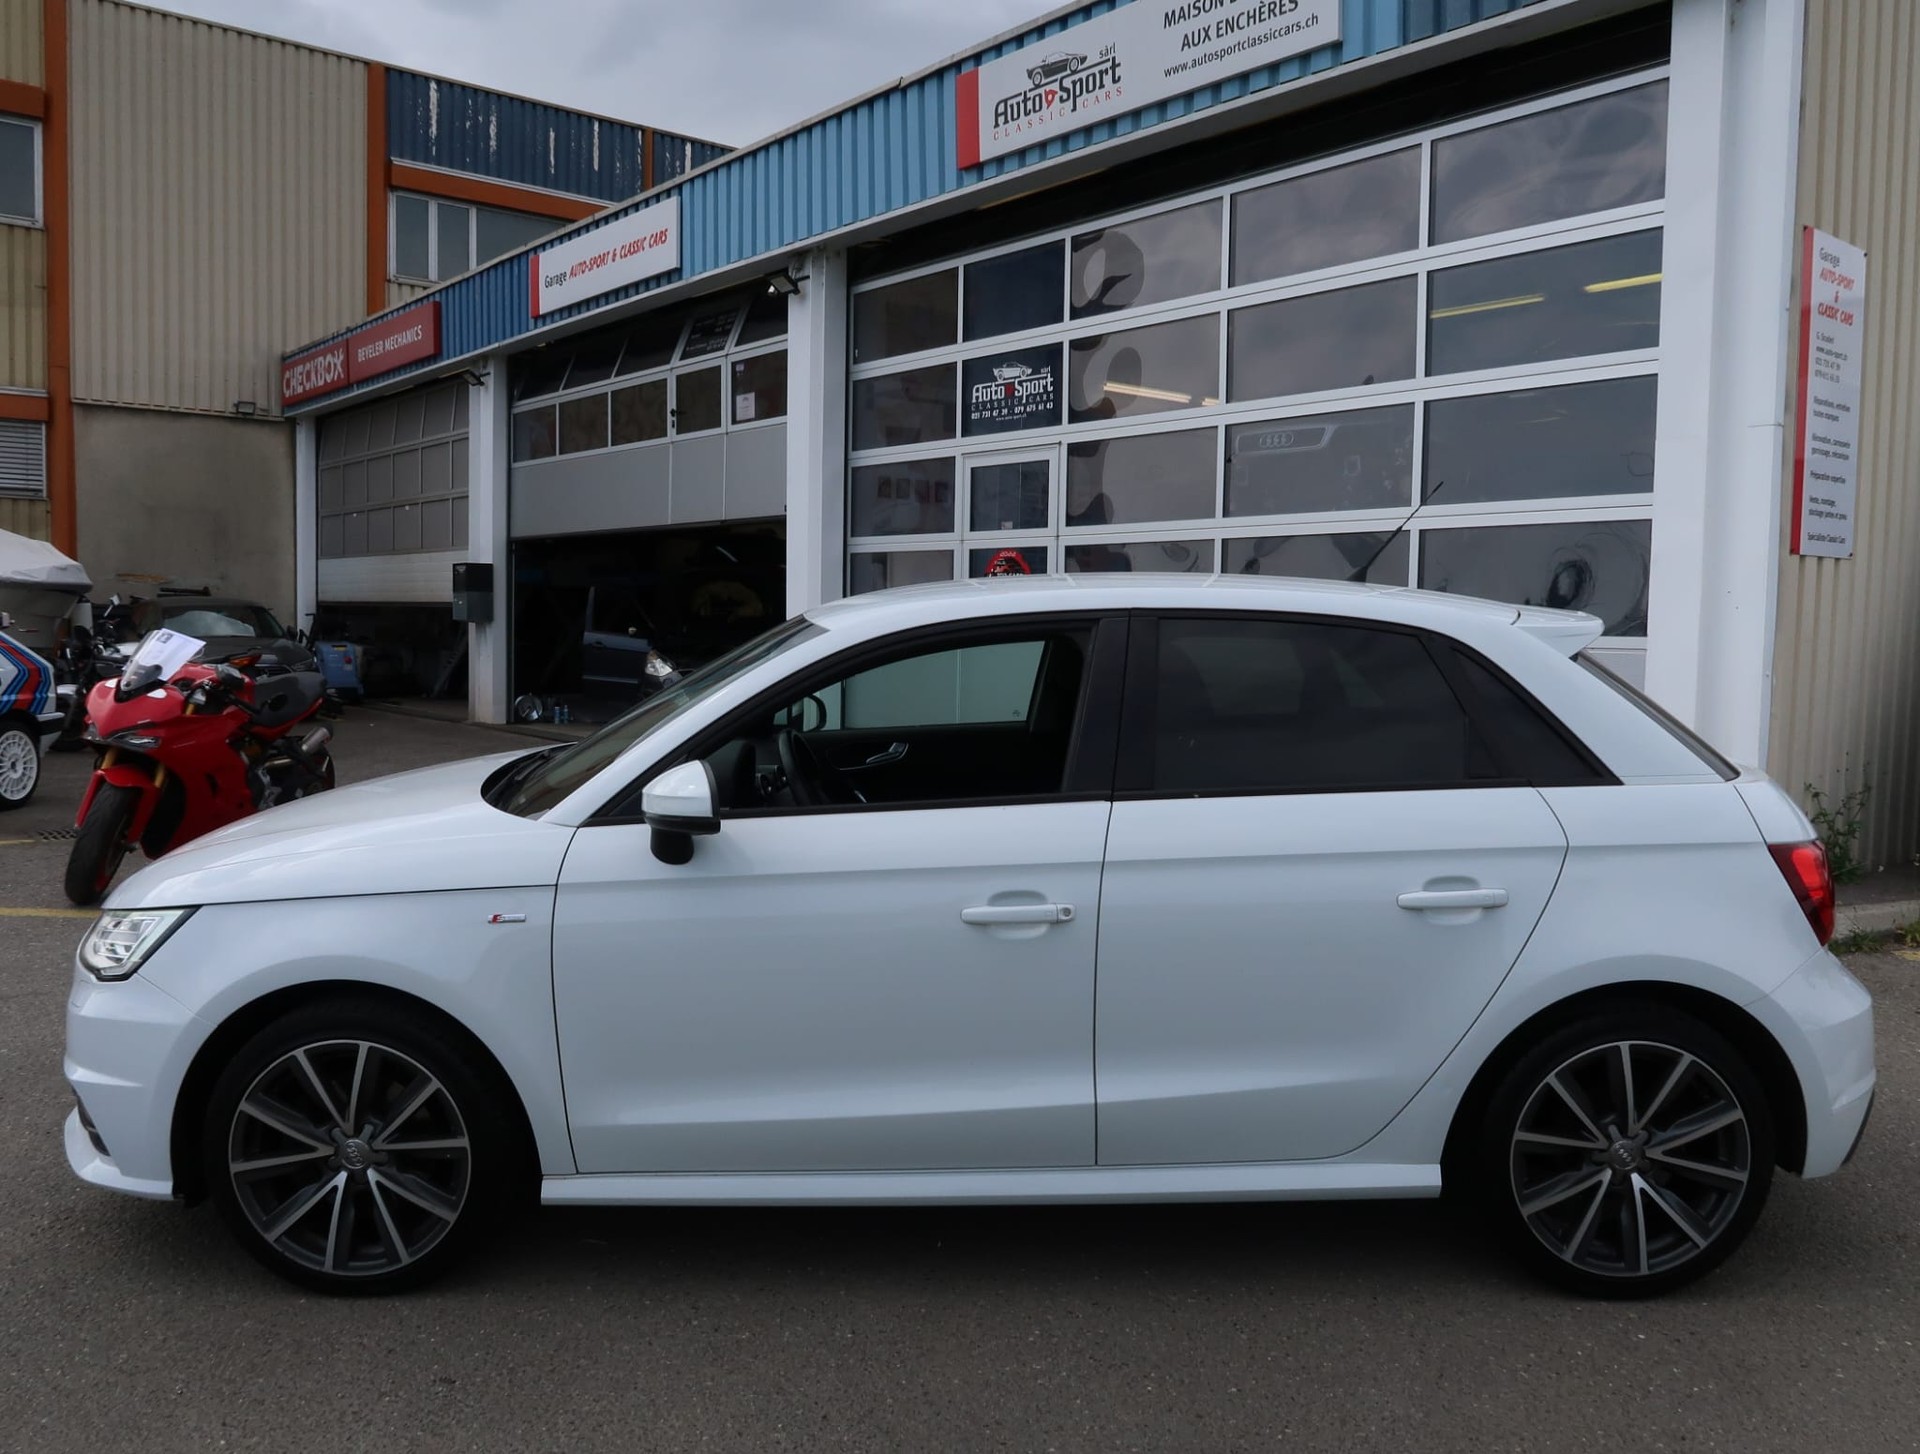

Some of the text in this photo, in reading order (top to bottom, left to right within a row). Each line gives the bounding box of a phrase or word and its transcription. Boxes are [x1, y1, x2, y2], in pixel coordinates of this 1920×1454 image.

[1163, 12, 1319, 78] www.autosportclassiccars.ch
[1181, 0, 1299, 52] AUX ENCHÈRES
[993, 56, 1121, 129] Auto Sport
[993, 86, 1122, 141] CLASSIC CARS
[544, 271, 568, 288] Garage
[569, 251, 610, 279] AUTO-SPORT
[619, 237, 647, 260] CLASSIC
[648, 228, 668, 249] CARS
[1819, 247, 1840, 268] Garage
[385, 325, 422, 352] MECHANICS
[1818, 302, 1854, 326] CLASSIC CARS
[283, 348, 345, 398] CHECKBOX
[972, 372, 1054, 404] Auto Sport
[971, 393, 1054, 411] CLASSIC CARS
